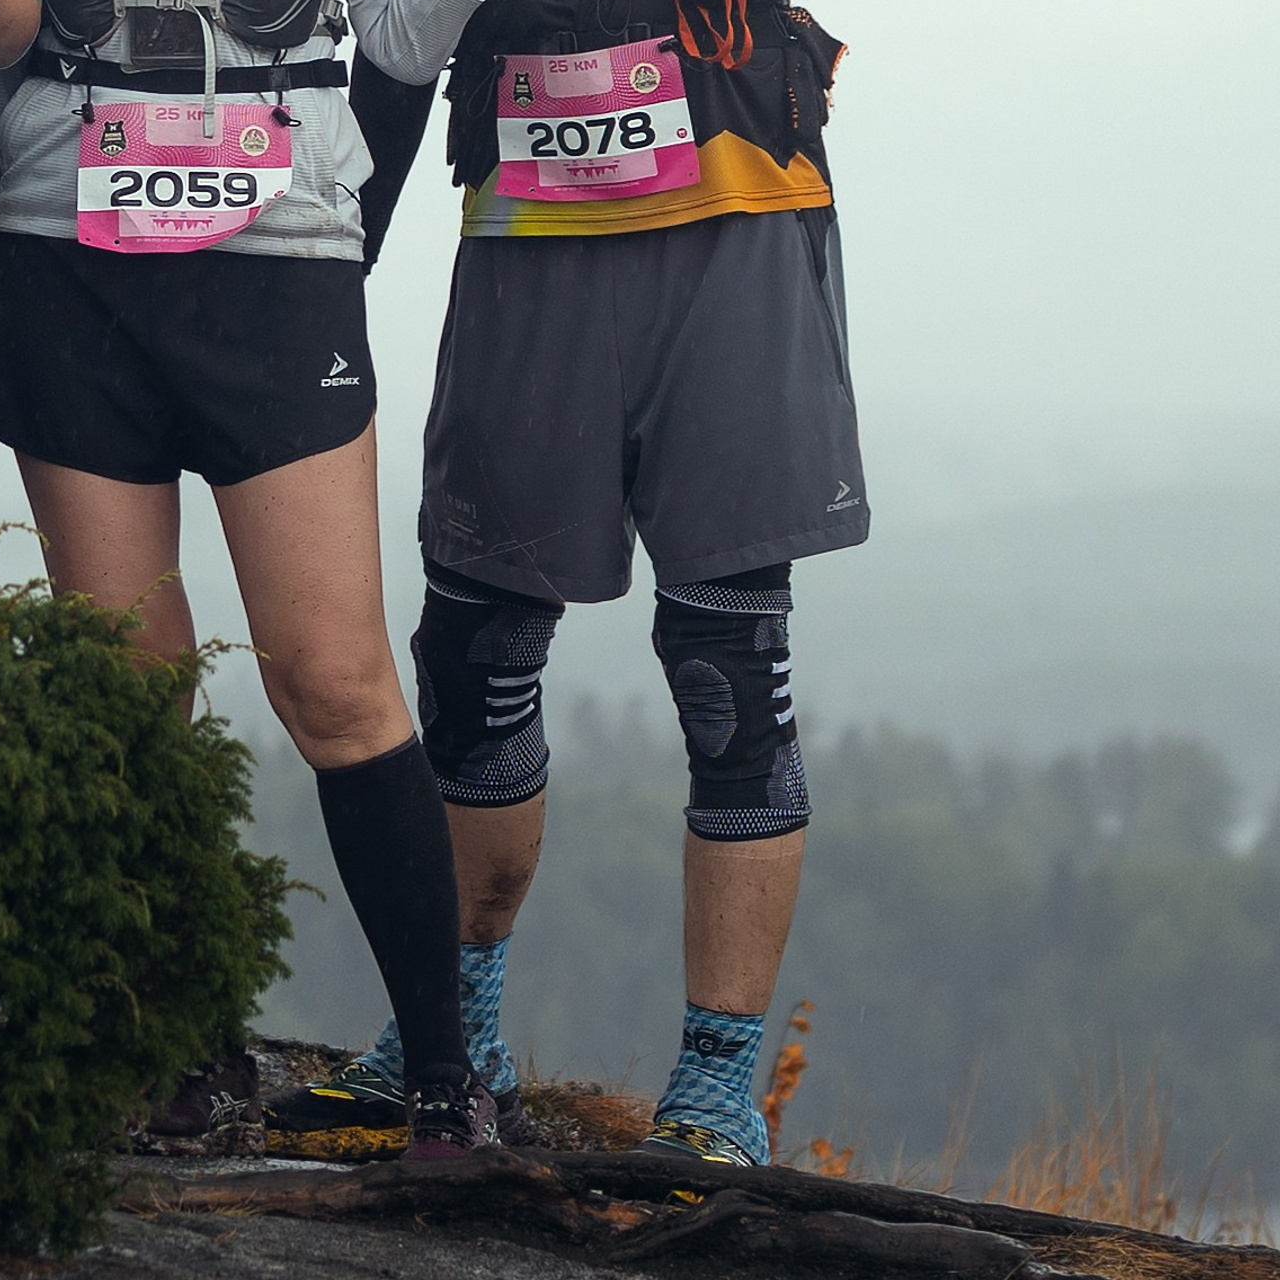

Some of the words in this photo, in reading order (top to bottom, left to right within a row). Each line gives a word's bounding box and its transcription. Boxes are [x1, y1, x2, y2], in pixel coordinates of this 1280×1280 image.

[549, 59, 568, 73] 25
[574, 58, 598, 71] KM
[155, 107, 180, 120] 25
[526, 111, 656, 158] 2078
[110, 170, 258, 208] 2059
[699, 1038, 713, 1051] G
